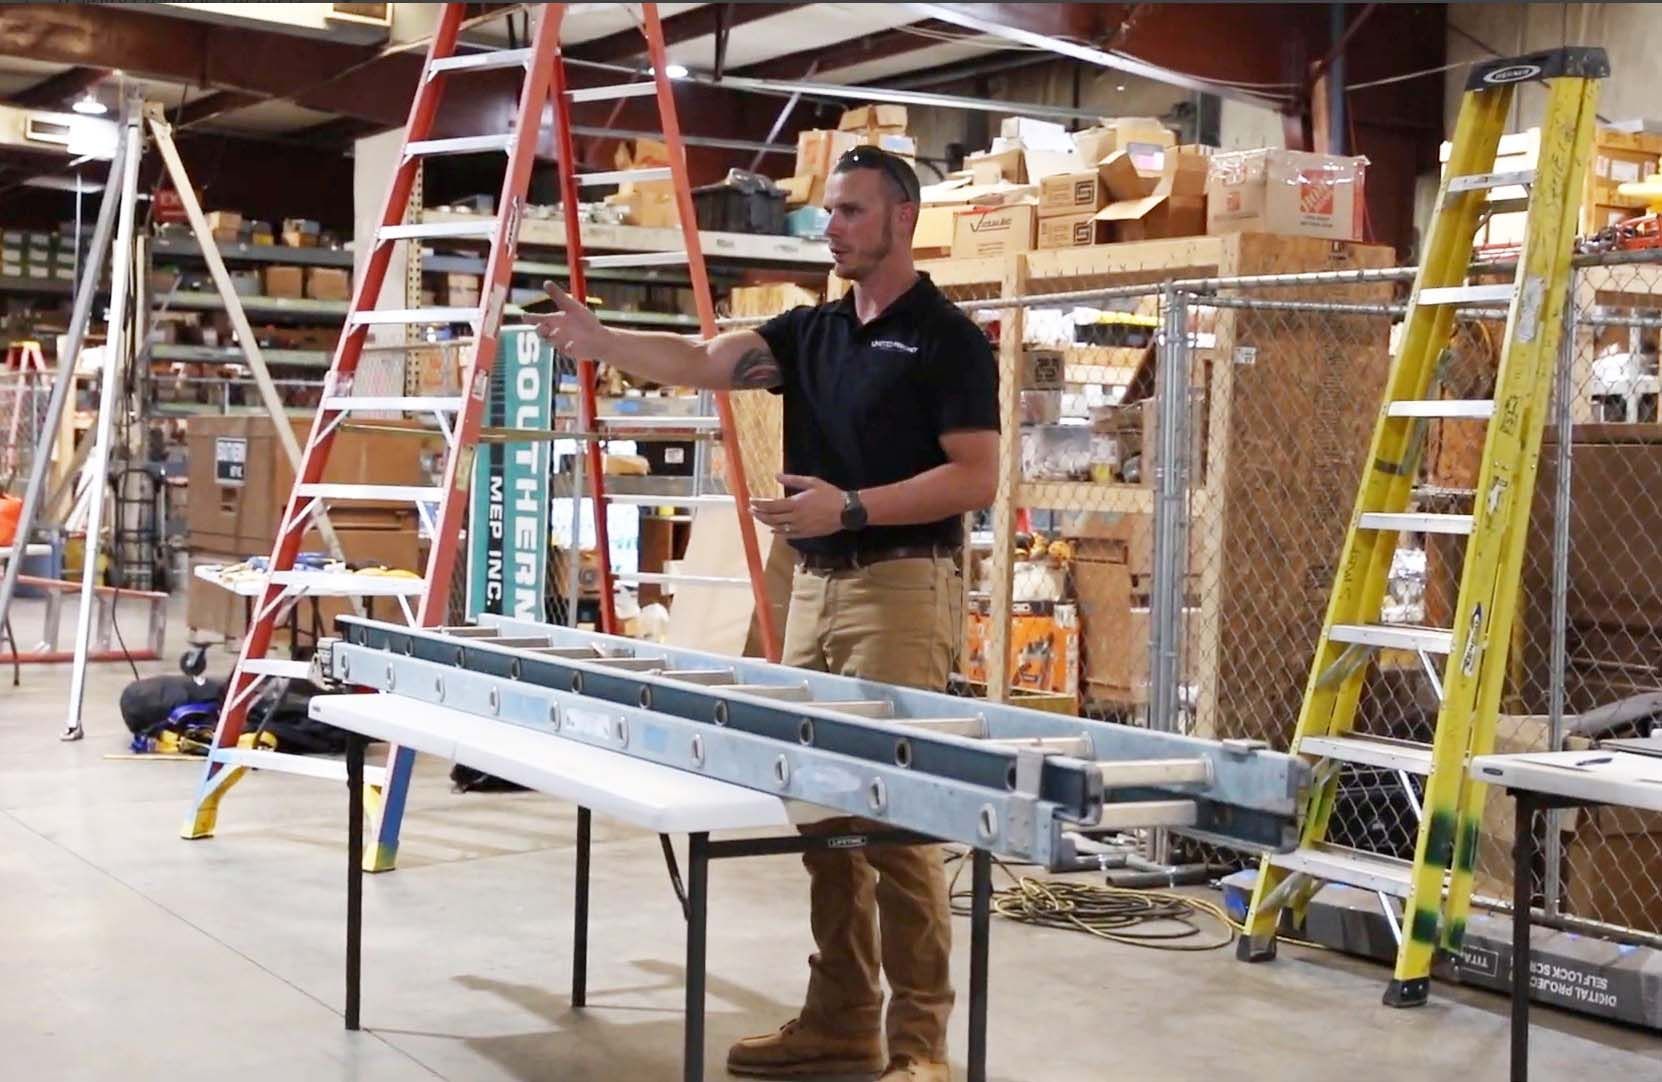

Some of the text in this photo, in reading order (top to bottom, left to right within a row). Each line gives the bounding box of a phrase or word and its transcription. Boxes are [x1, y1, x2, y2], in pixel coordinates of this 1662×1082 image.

[514, 331, 541, 623] SOUTHERN
[486, 475, 504, 606] MEP INC.
[1462, 952, 1489, 968] TITA
[1552, 966, 1581, 984] LOCK
[1583, 972, 1608, 989] SELF
[1529, 977, 1573, 996] PROJEC
